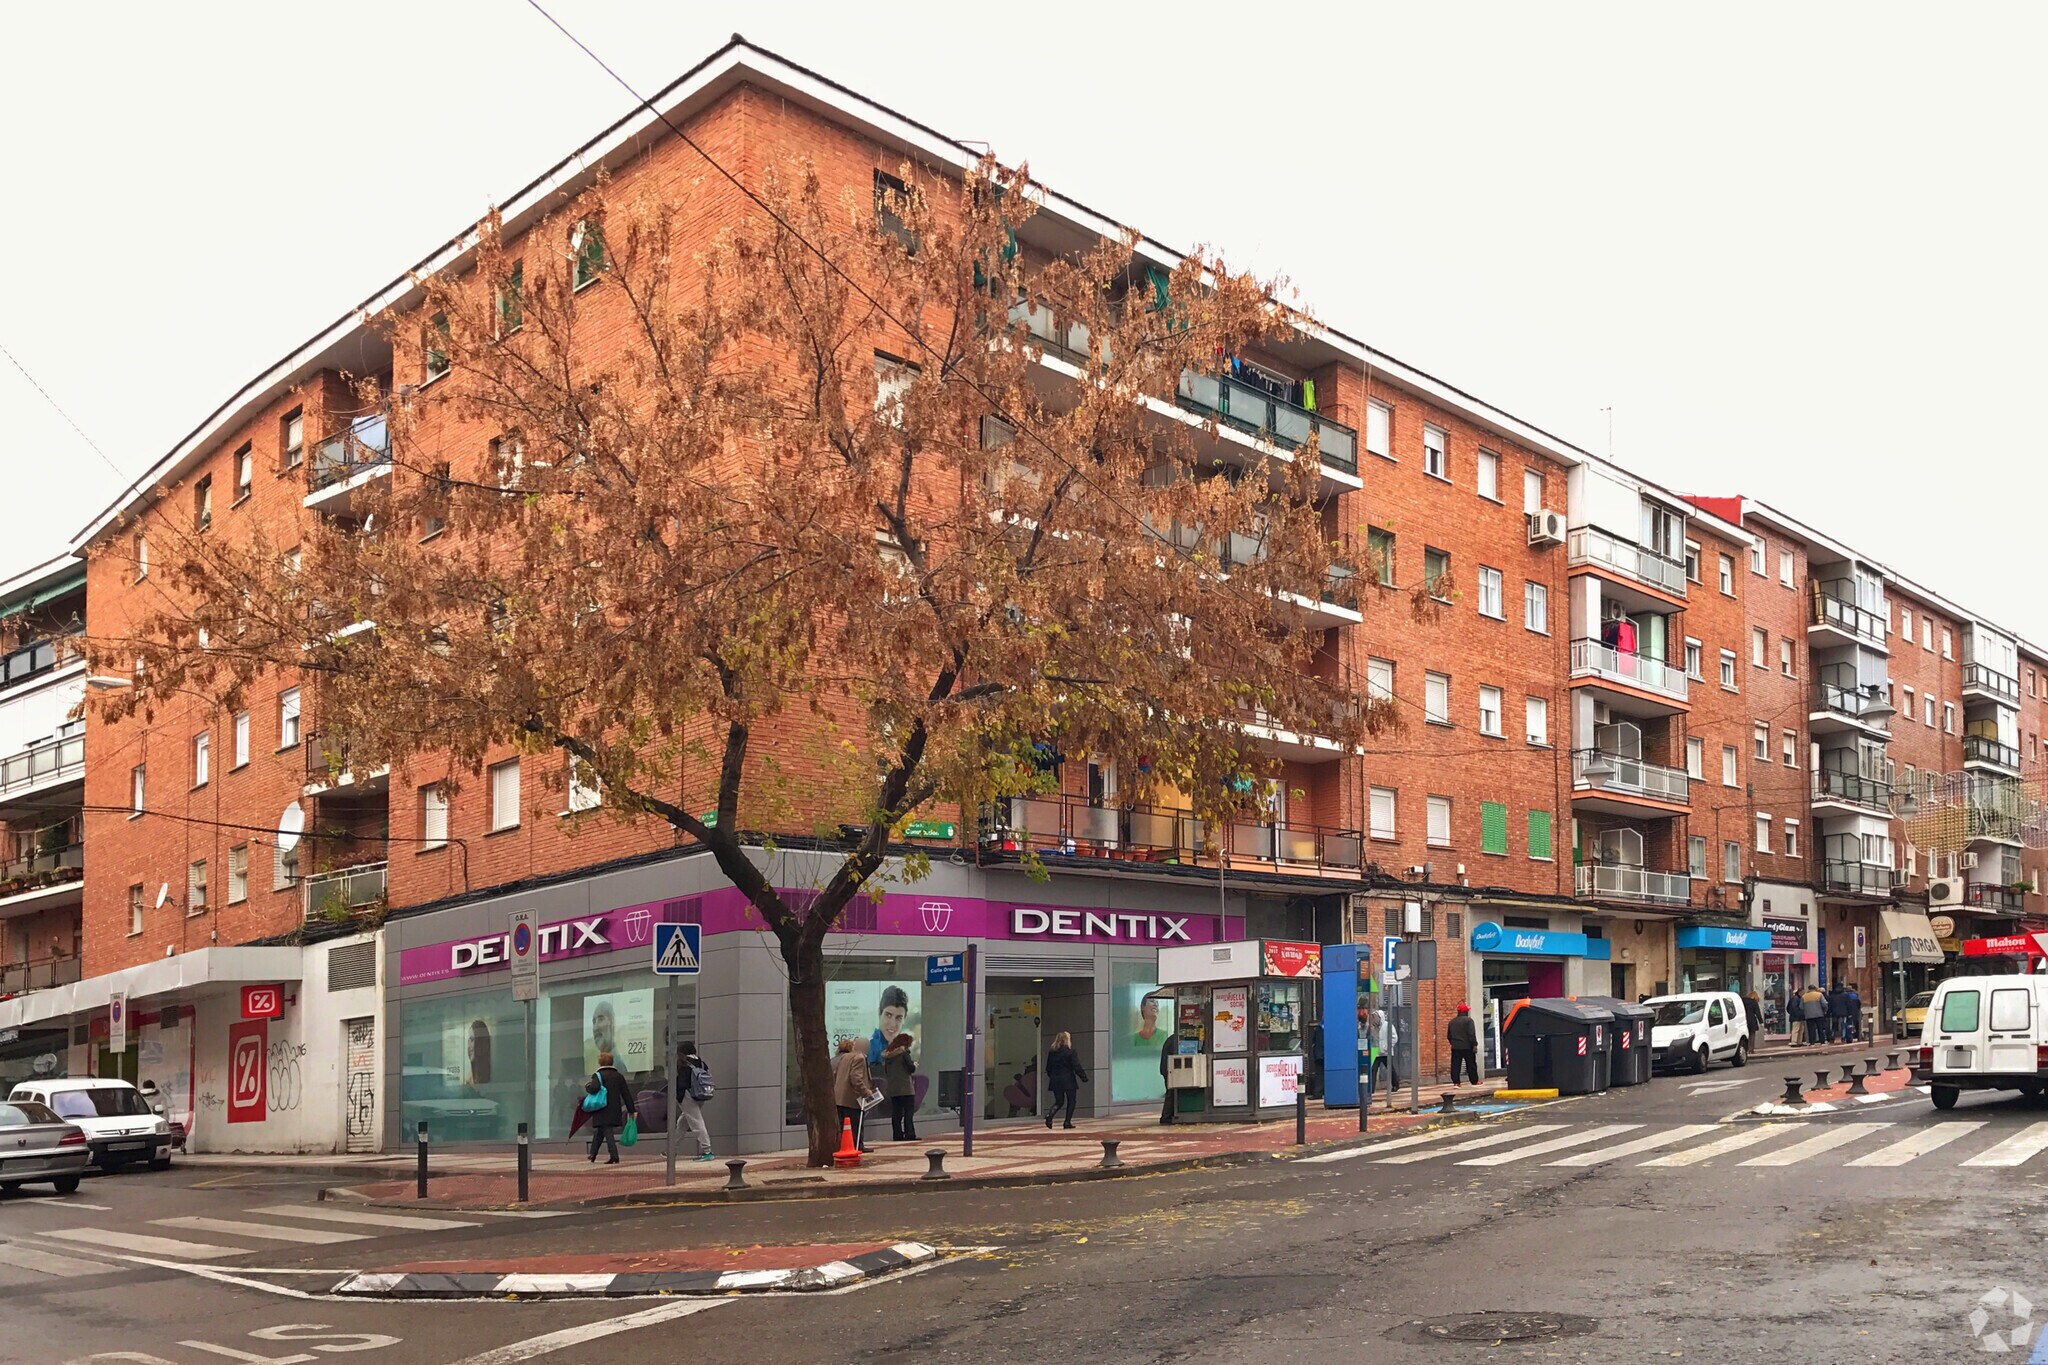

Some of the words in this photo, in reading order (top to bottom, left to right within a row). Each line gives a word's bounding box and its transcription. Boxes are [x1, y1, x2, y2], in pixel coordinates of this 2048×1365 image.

[1015, 898, 1191, 941] DENTIX
[1880, 943, 1892, 951] CAF
[1986, 937, 2026, 948] Mahou
[627, 1041, 648, 1055] 222€
